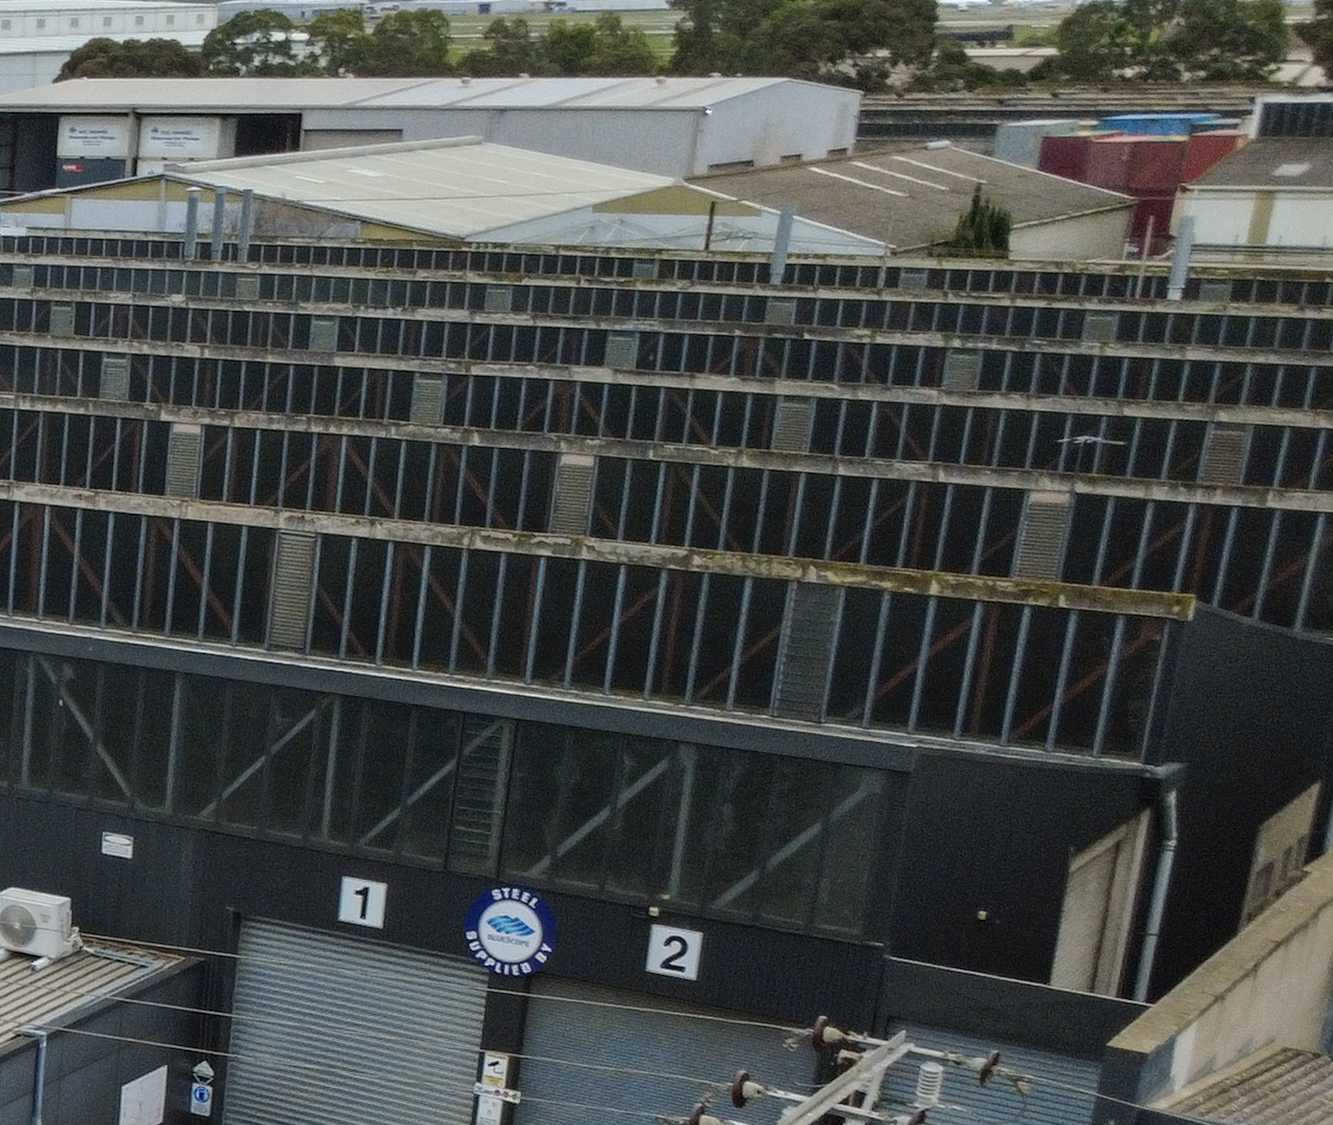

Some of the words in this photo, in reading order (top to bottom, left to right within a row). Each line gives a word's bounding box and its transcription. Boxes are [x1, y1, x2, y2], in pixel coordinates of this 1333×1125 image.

[354, 886, 370, 920] 1
[490, 886, 539, 910] STEEL
[465, 930, 532, 977] SUPPLIED
[534, 942, 553, 964] BY
[660, 935, 689, 974] 2
